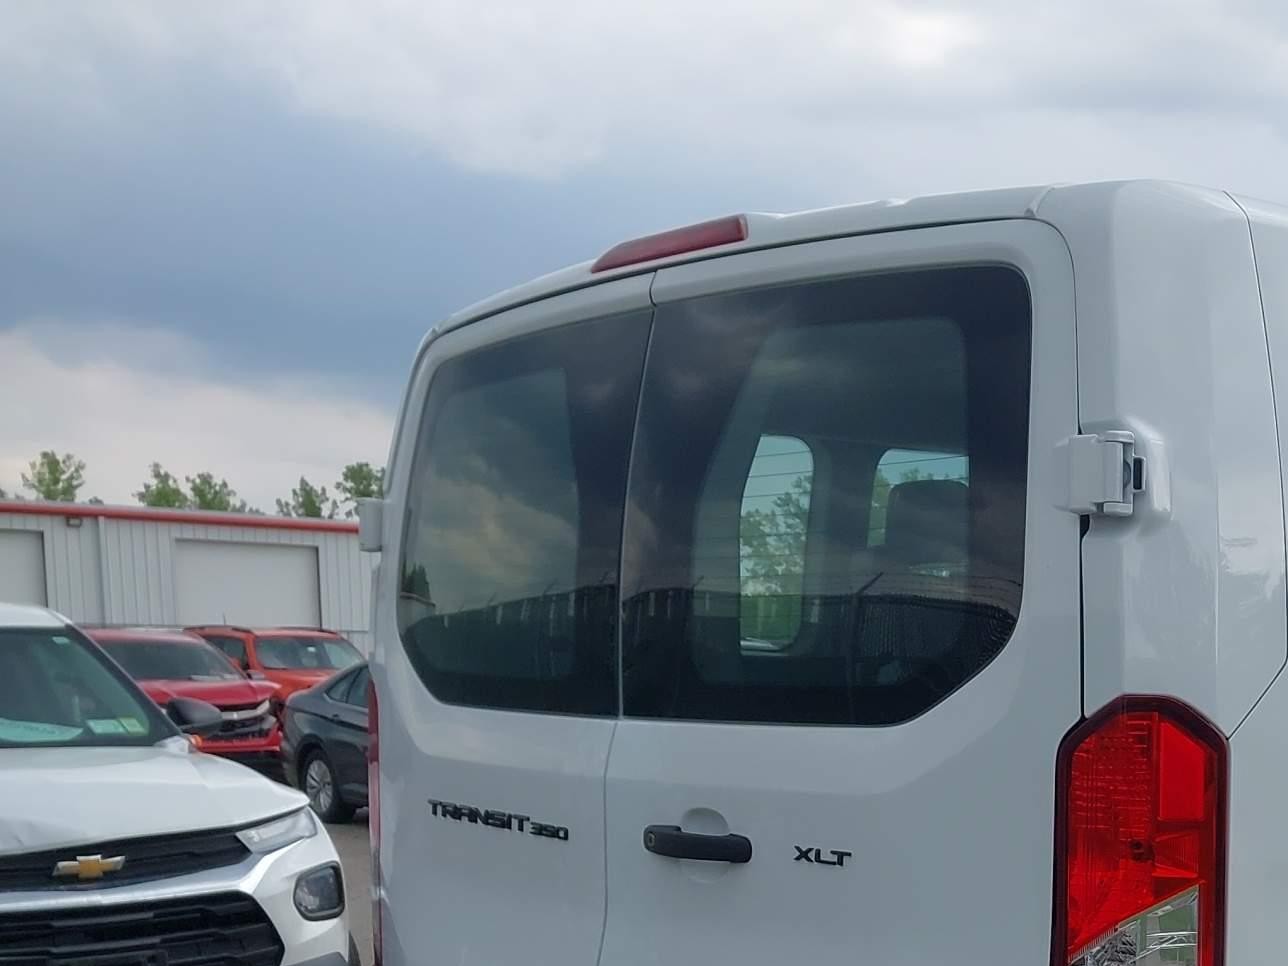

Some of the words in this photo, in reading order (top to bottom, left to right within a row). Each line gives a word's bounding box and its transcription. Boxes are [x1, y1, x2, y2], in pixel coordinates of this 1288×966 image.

[427, 798, 531, 833] TRANSIT
[529, 821, 570, 841] 350
[793, 845, 853, 867] XLT
